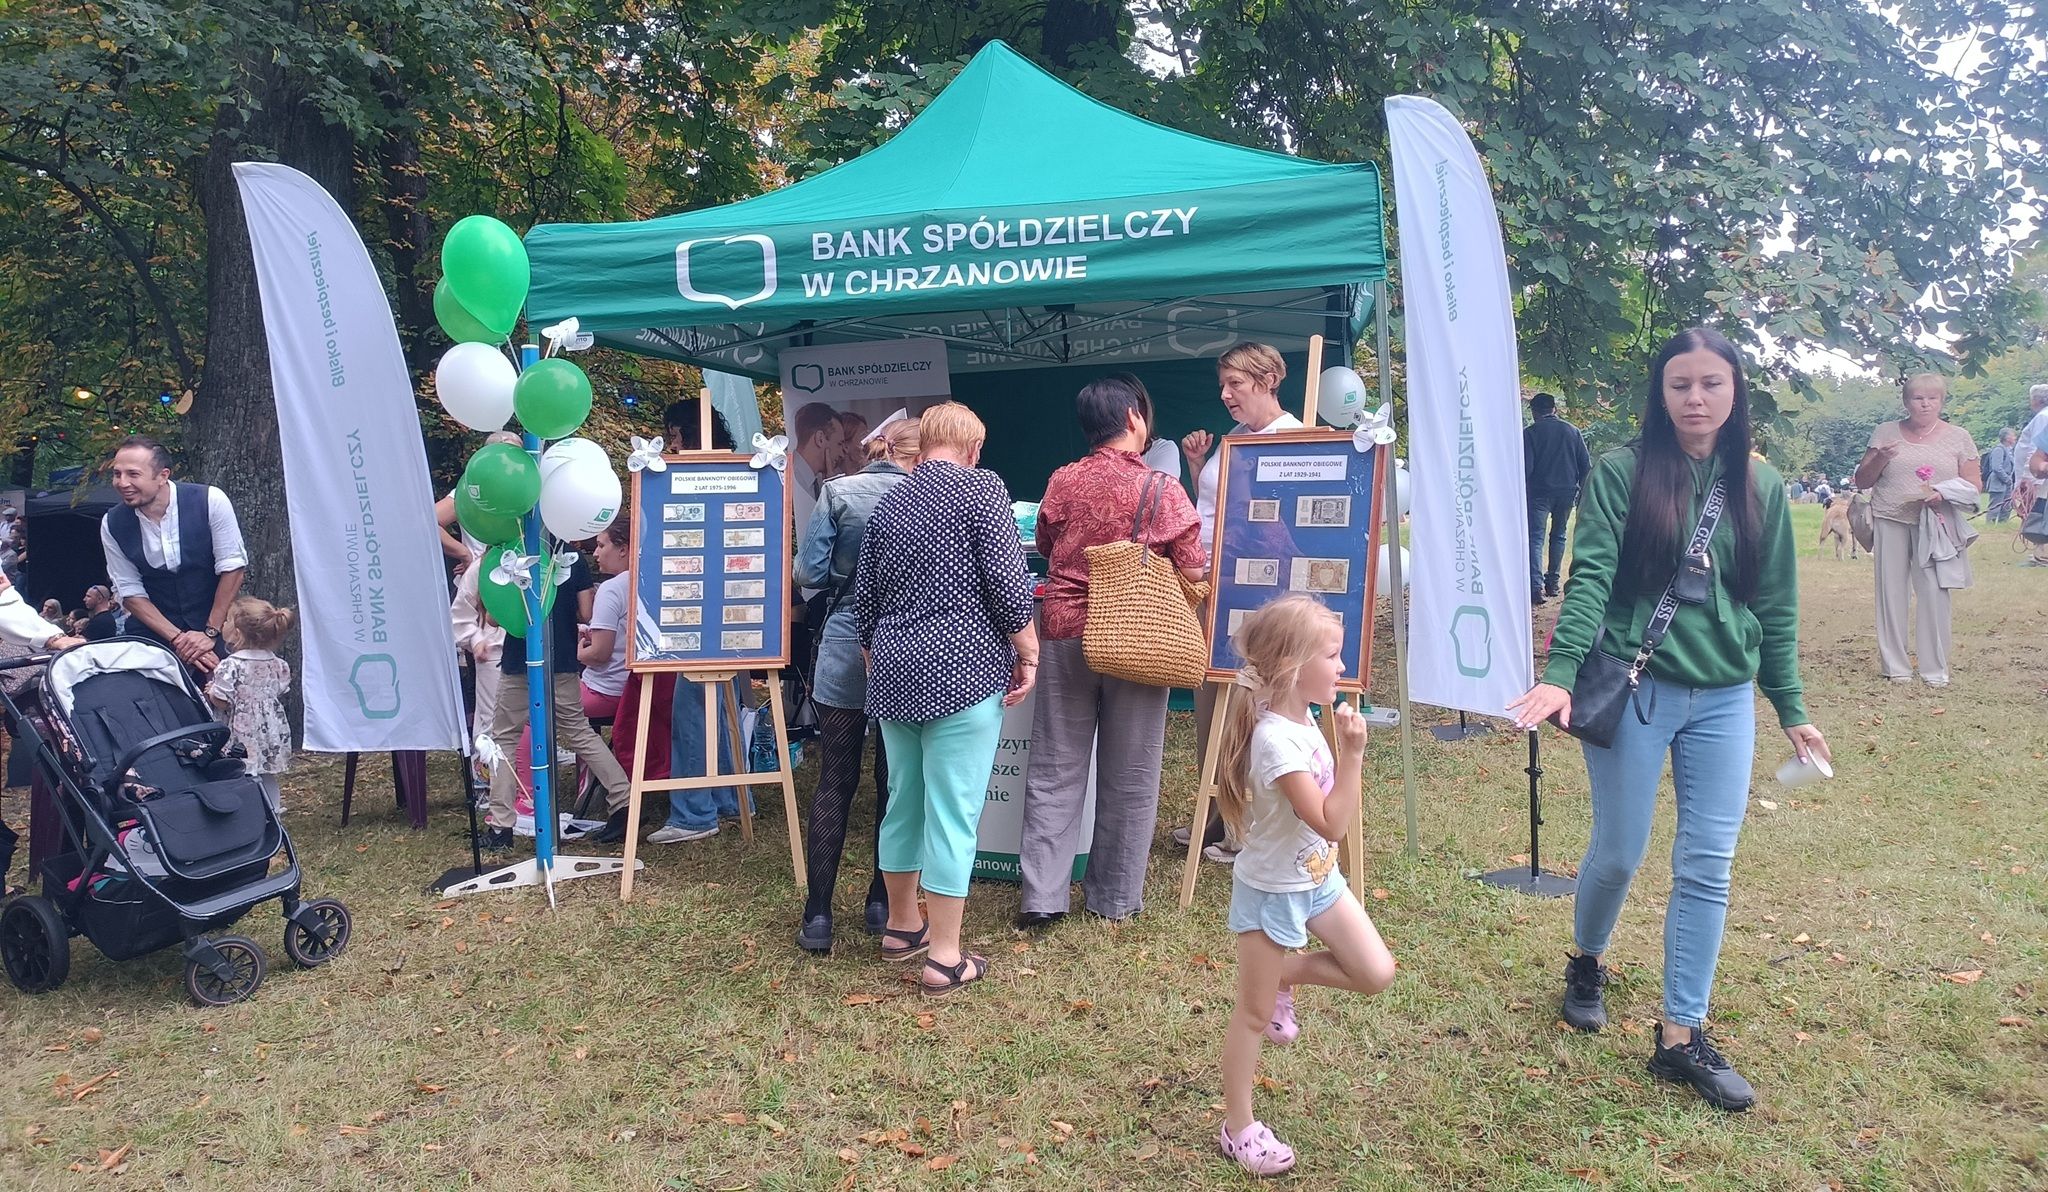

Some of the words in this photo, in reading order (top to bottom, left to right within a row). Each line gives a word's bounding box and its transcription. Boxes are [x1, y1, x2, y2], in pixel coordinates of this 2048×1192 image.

[811, 227, 912, 261] BANK
[922, 207, 1199, 253] SPÓŁDZIELCZY
[801, 272, 835, 298] W
[845, 255, 1087, 295] CHRZANOWIE
[828, 366, 855, 377] BANK
[858, 361, 932, 375] SPÓŁDZIELCZY
[839, 377, 888, 387] CHRZANOWIE
